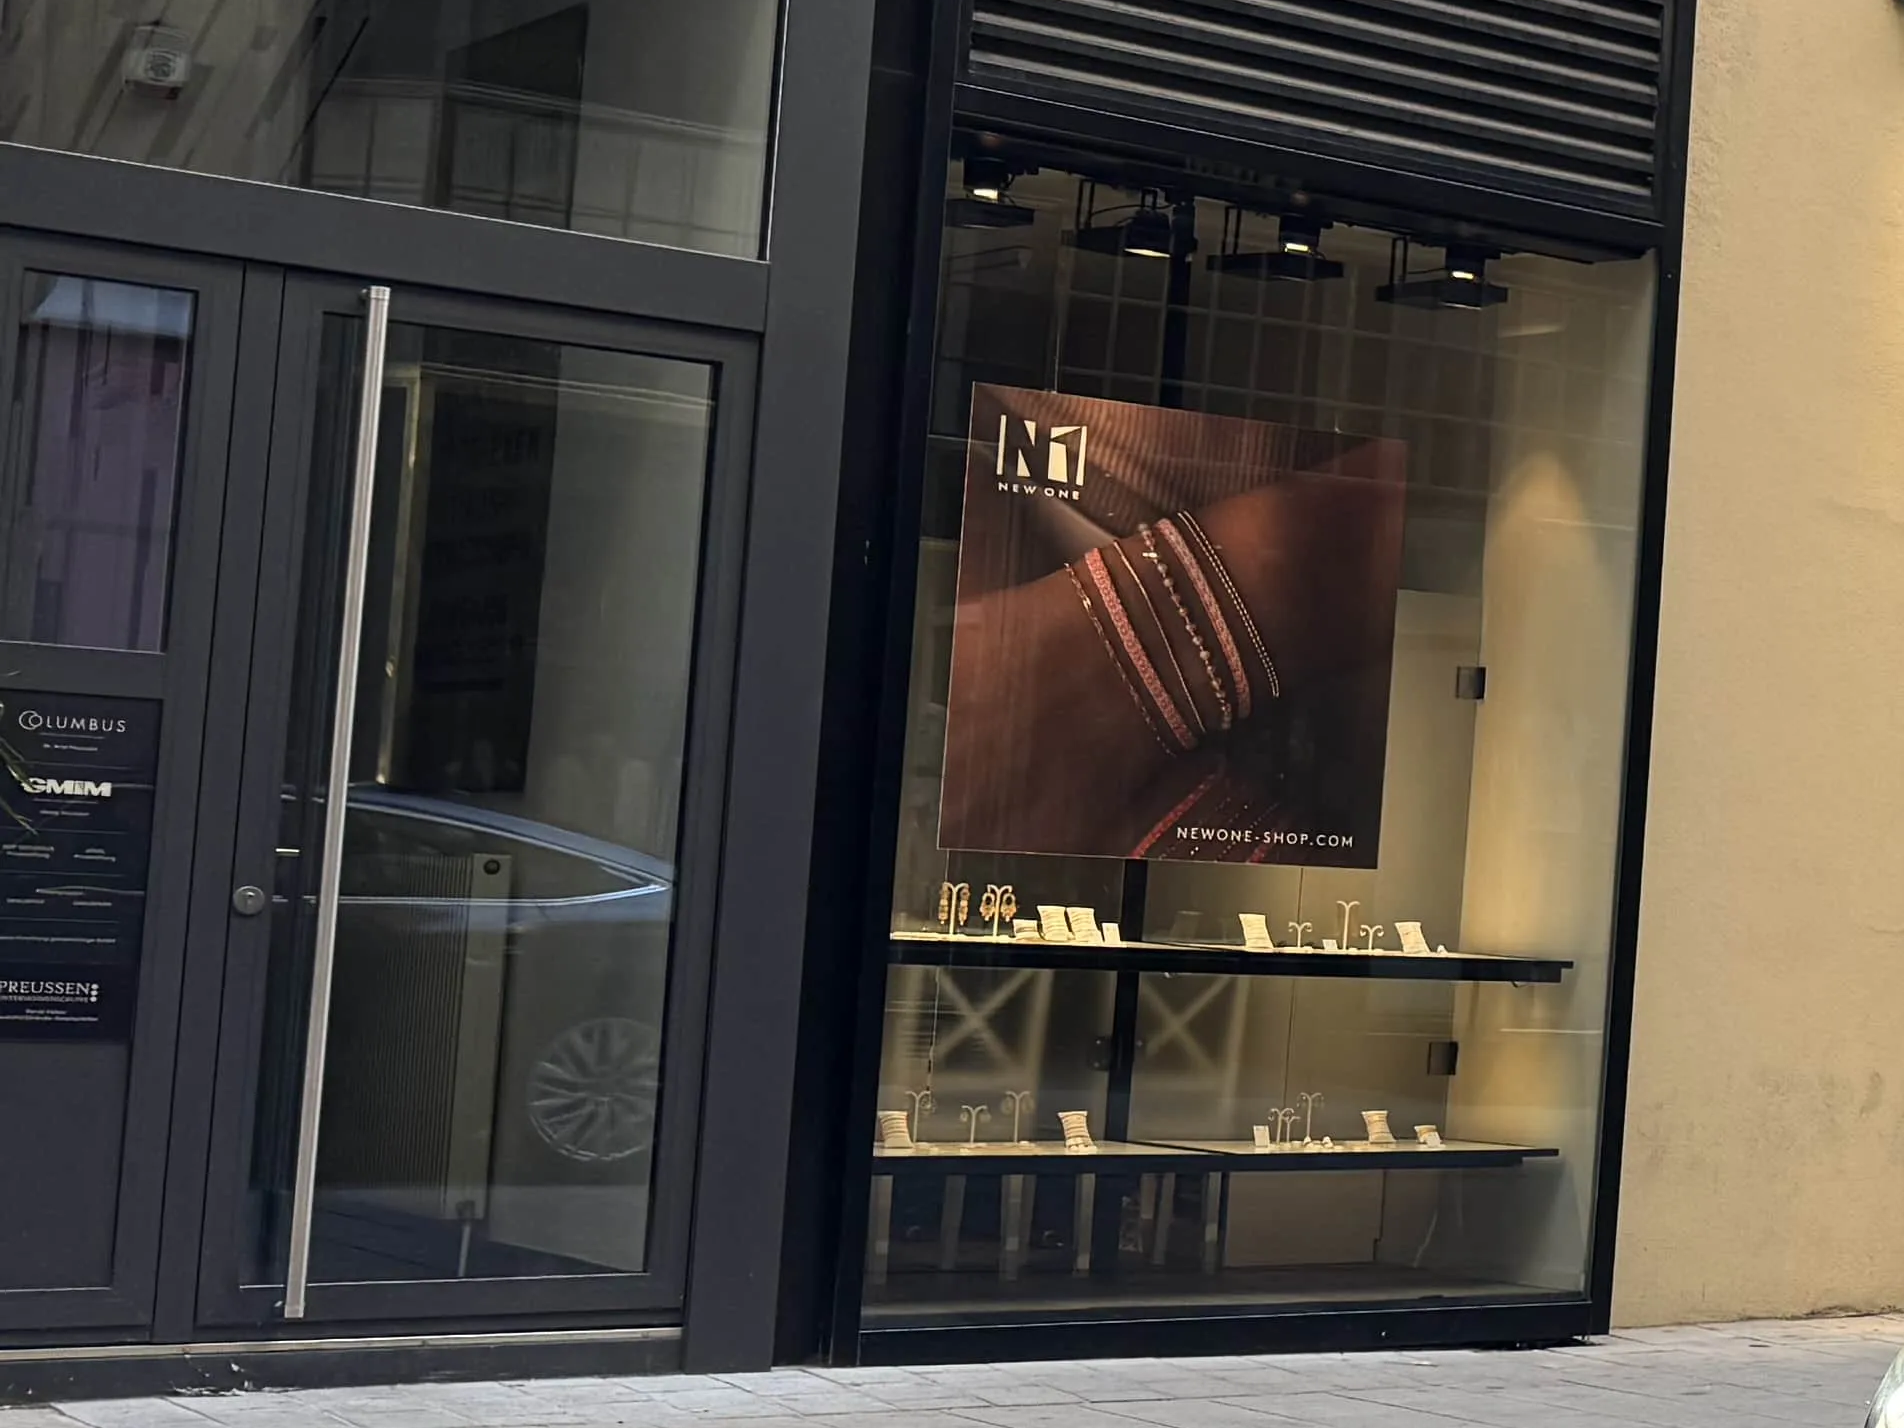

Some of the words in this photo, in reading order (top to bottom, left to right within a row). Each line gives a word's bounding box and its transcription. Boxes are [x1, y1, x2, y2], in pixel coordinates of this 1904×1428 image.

[998, 482, 1037, 495] NEW
[1043, 487, 1080, 501] ONE
[1176, 826, 1353, 848] NEWONE-SHOP.COM
